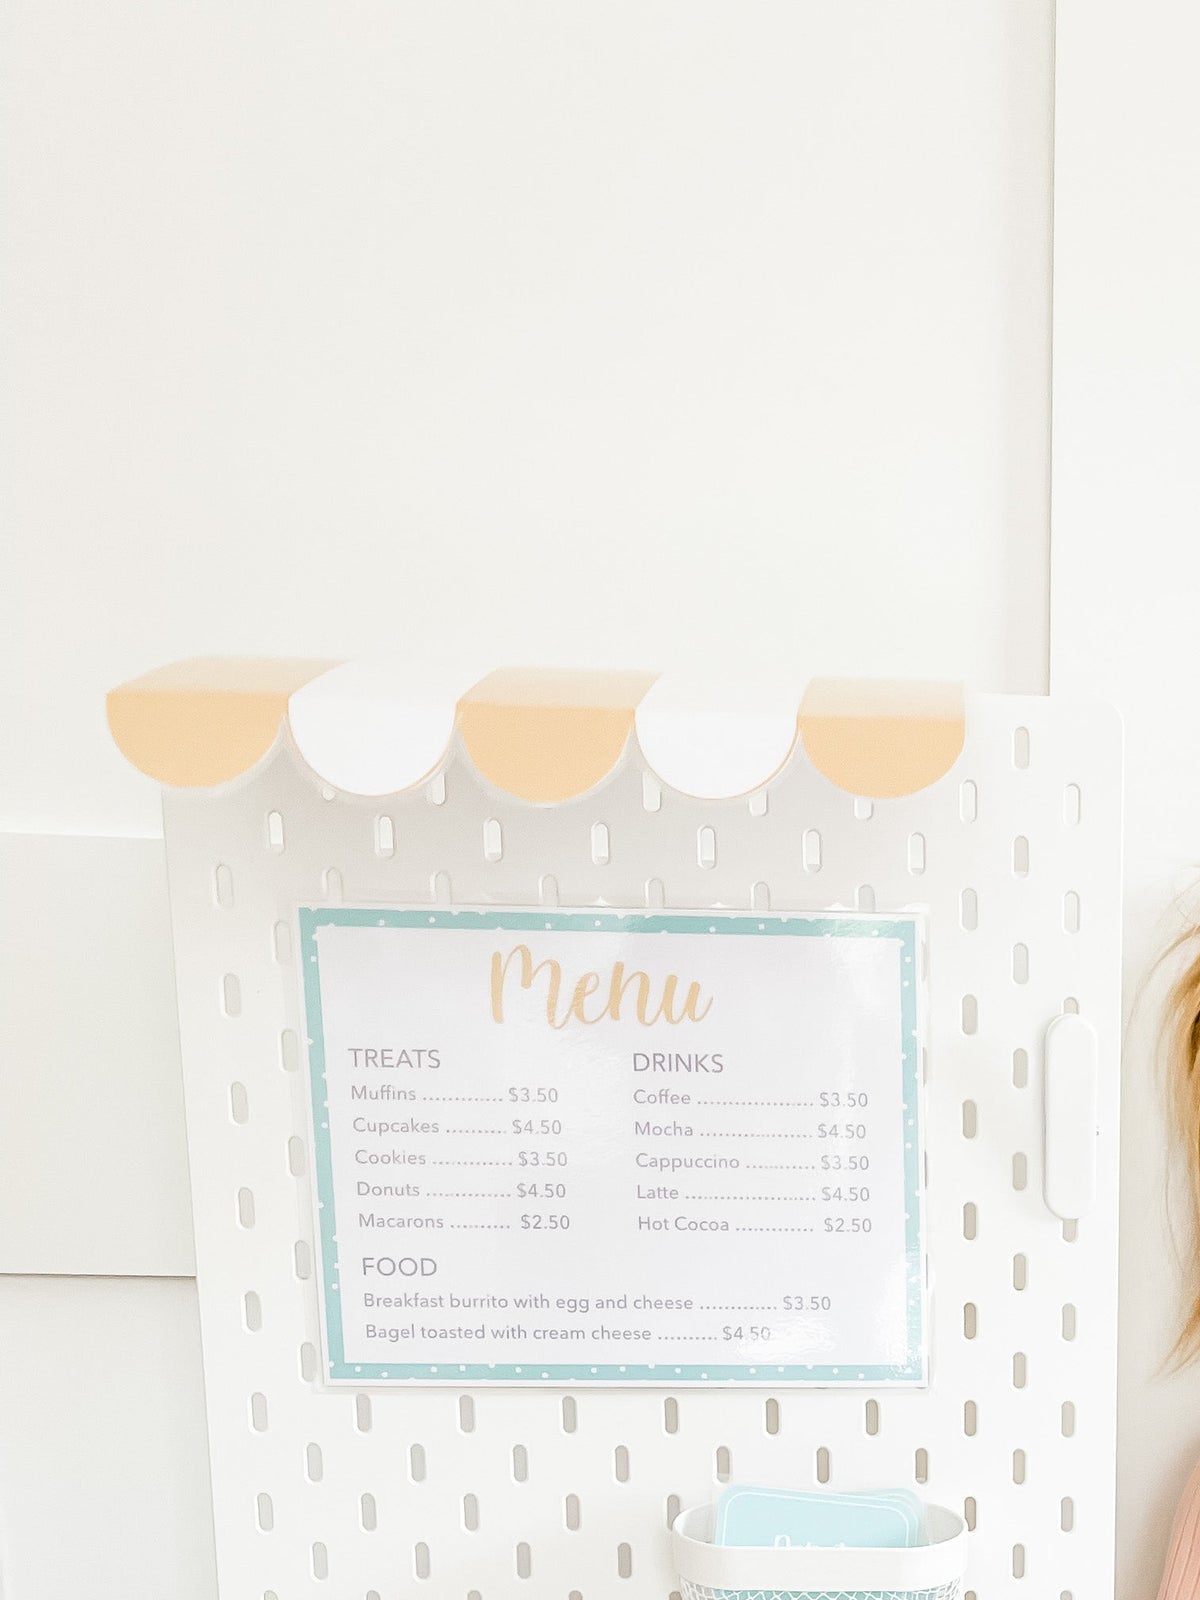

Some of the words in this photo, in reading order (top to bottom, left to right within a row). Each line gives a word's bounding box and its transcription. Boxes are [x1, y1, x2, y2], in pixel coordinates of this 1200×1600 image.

[489, 944, 714, 1030] Menu
[347, 1047, 441, 1069] TREATS
[632, 1053, 725, 1074] DRINKS
[351, 1085, 417, 1101] Muffins
[508, 1086, 559, 1103] $3.50
[633, 1088, 691, 1105] Coffee
[819, 1091, 869, 1108] $3.50
[352, 1117, 440, 1136] Cupcakes
[511, 1119, 562, 1135] $4.50
[634, 1121, 694, 1137] Mocha
[817, 1123, 867, 1140] $4.50
[354, 1149, 427, 1166] Cookies
[518, 1151, 568, 1167] $3.50
[635, 1153, 740, 1172] Cappuccino
[820, 1155, 870, 1171] $3.50
[356, 1181, 420, 1197] Donuts
[516, 1182, 567, 1199] $4.50
[636, 1185, 679, 1200] Latte
[821, 1186, 871, 1203] $4.50
[358, 1212, 444, 1229] Macarons
[520, 1214, 570, 1231] $2.50
[638, 1216, 670, 1232] Hot
[674, 1217, 730, 1232] Cocoa
[823, 1217, 873, 1234] $2.50
[362, 1257, 438, 1276] FOOD
[363, 1293, 445, 1309] Breakfast
[449, 1293, 509, 1309] burrito
[513, 1294, 550, 1309] with
[555, 1297, 590, 1313] egg
[594, 1294, 628, 1309] and
[633, 1295, 694, 1310] cheese
[782, 1295, 832, 1311] $3.50
[365, 1323, 416, 1342] Bagel
[420, 1324, 486, 1340] toasted
[490, 1325, 528, 1340] with
[532, 1327, 586, 1340] cream
[591, 1326, 652, 1340] cheese
